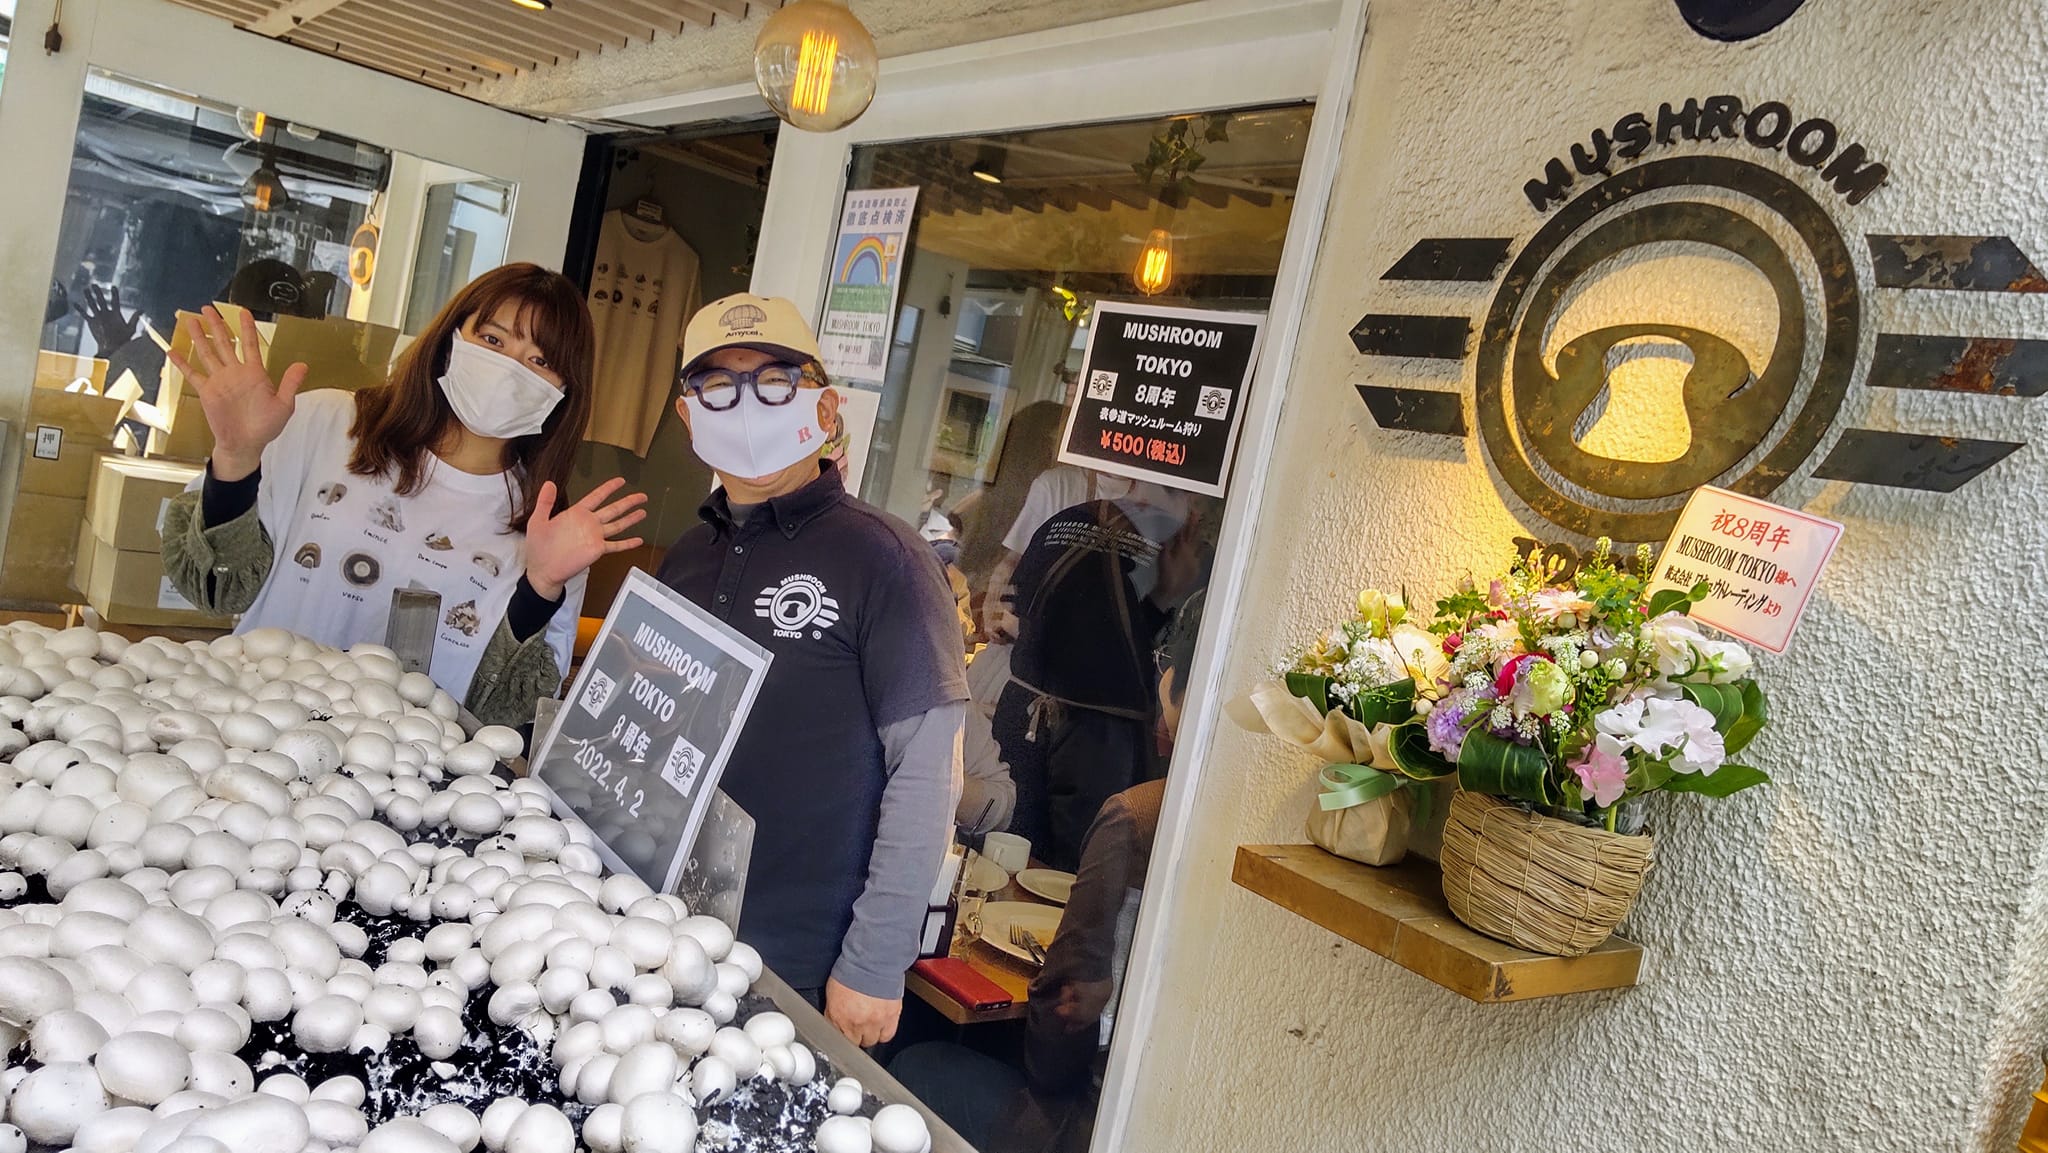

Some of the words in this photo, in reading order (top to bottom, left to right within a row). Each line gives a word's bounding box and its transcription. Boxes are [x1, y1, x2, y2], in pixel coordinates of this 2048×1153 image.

[1523, 94, 1889, 213] MUSHROOM
[1122, 321, 1223, 349] MUSHROOM
[1135, 354, 1193, 378] TOKYO
[1134, 384, 1177, 409] 8周年
[1099, 407, 1202, 437] 表参道マッシュルーム狩り
[1711, 508, 1791, 552] 祝8周年
[1676, 534, 1739, 571] MUSHROOM
[780, 573, 827, 594] MUSHROOM
[1664, 564, 1692, 587] 株式会社
[773, 629, 803, 640] TOKYO
[633, 622, 718, 695] MUSHROOM
[628, 672, 676, 723] TOKYO
[611, 714, 652, 761] 8周年
